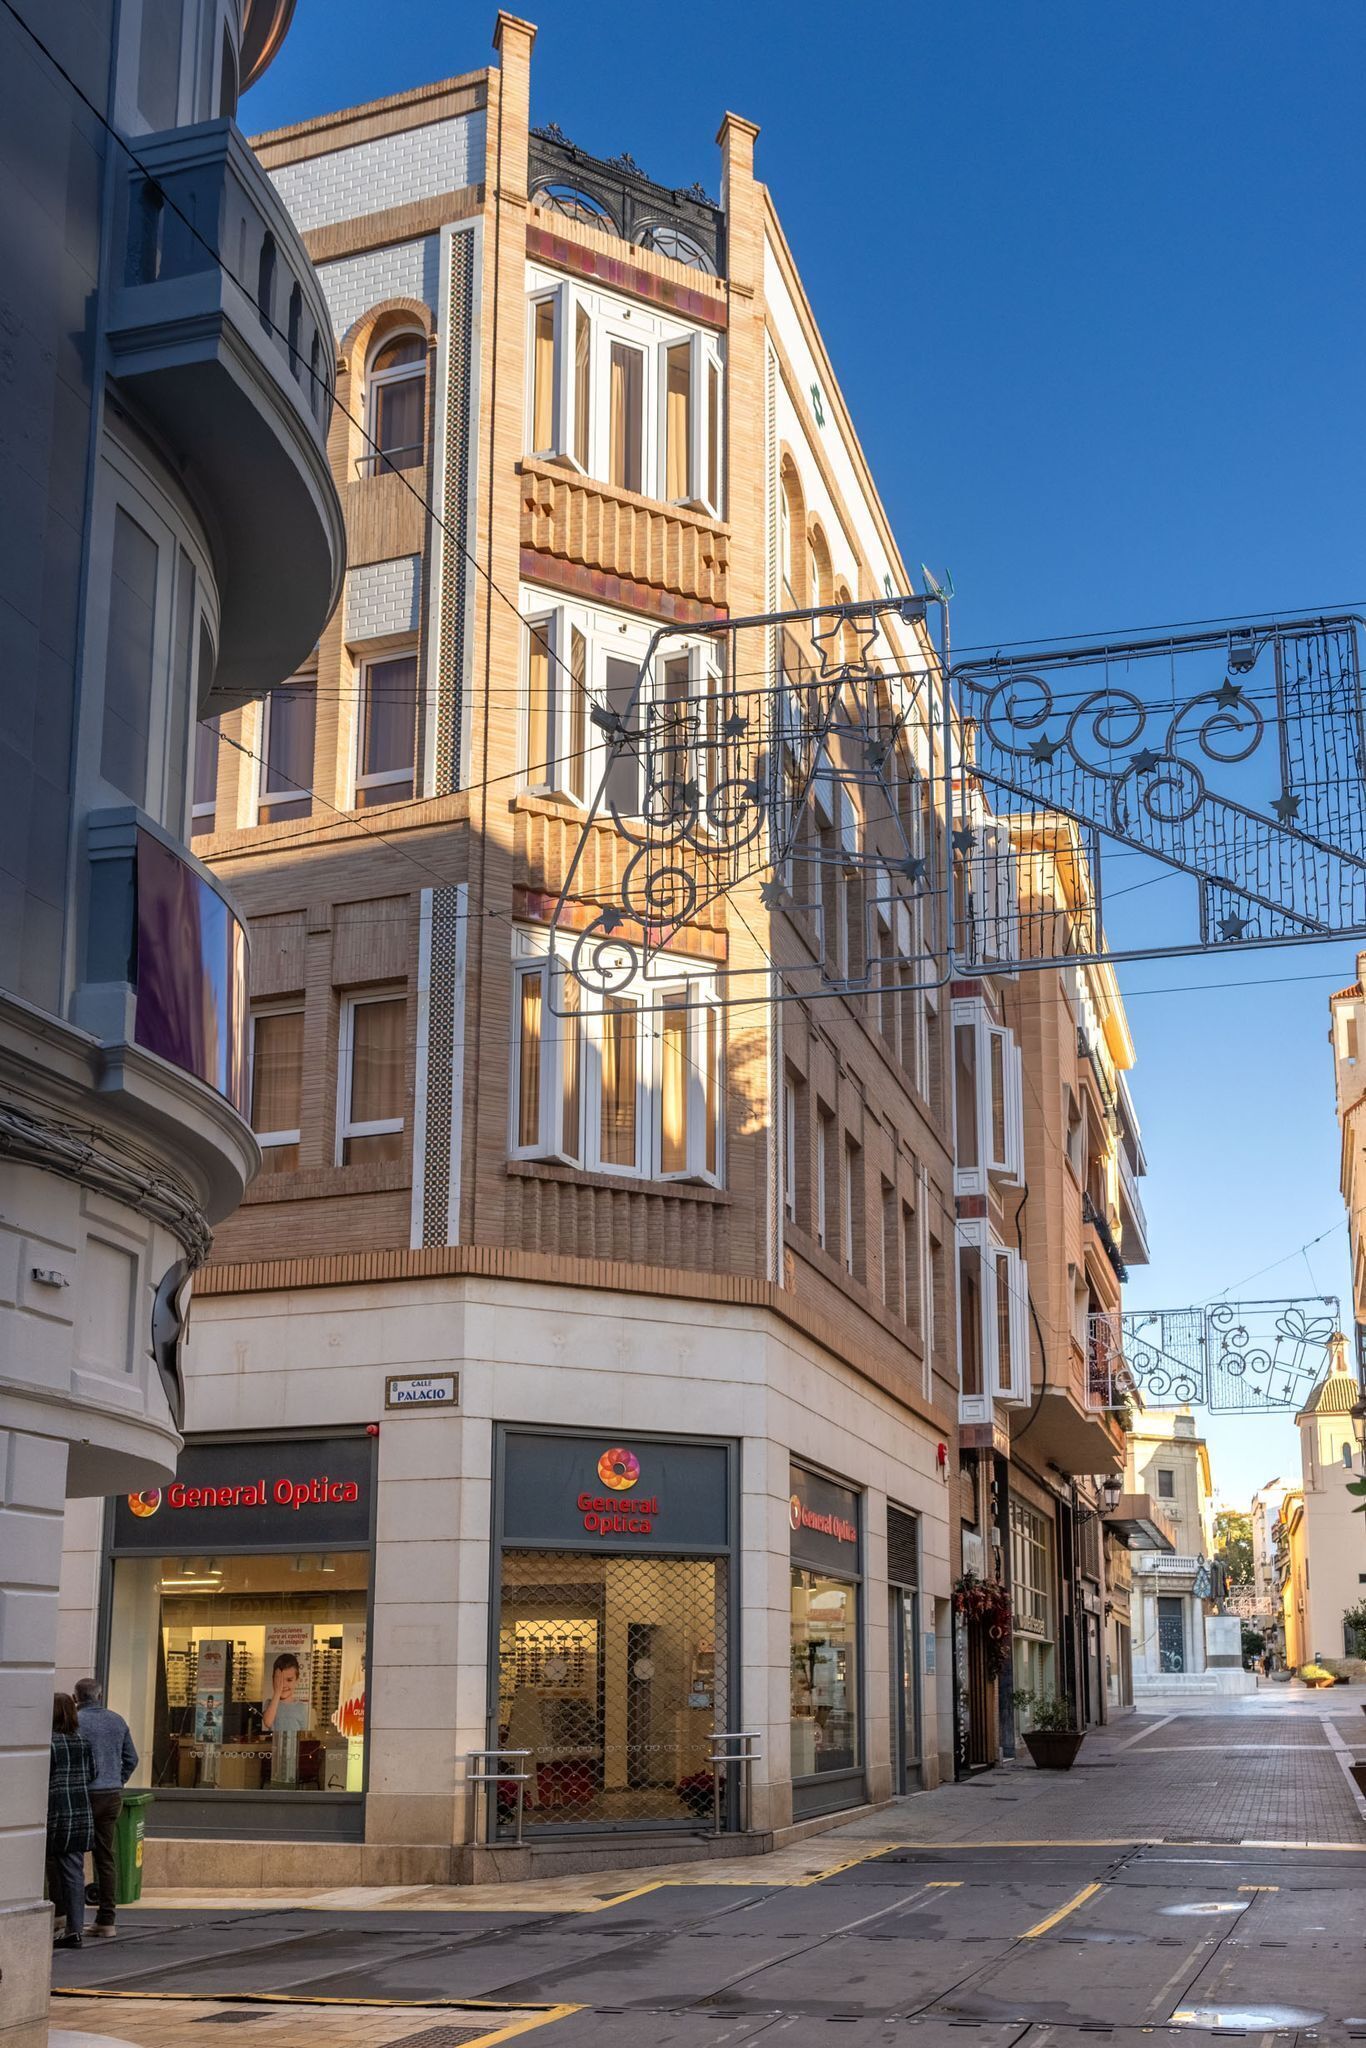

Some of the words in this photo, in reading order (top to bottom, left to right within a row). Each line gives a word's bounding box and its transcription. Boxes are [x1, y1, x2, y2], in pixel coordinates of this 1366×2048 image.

[397, 1389, 445, 1401] PALACIO
[168, 1480, 267, 1508] General
[273, 1476, 358, 1510] Optica
[577, 1492, 658, 1514] General
[584, 1512, 652, 1535] Optica
[802, 1504, 833, 1535] General
